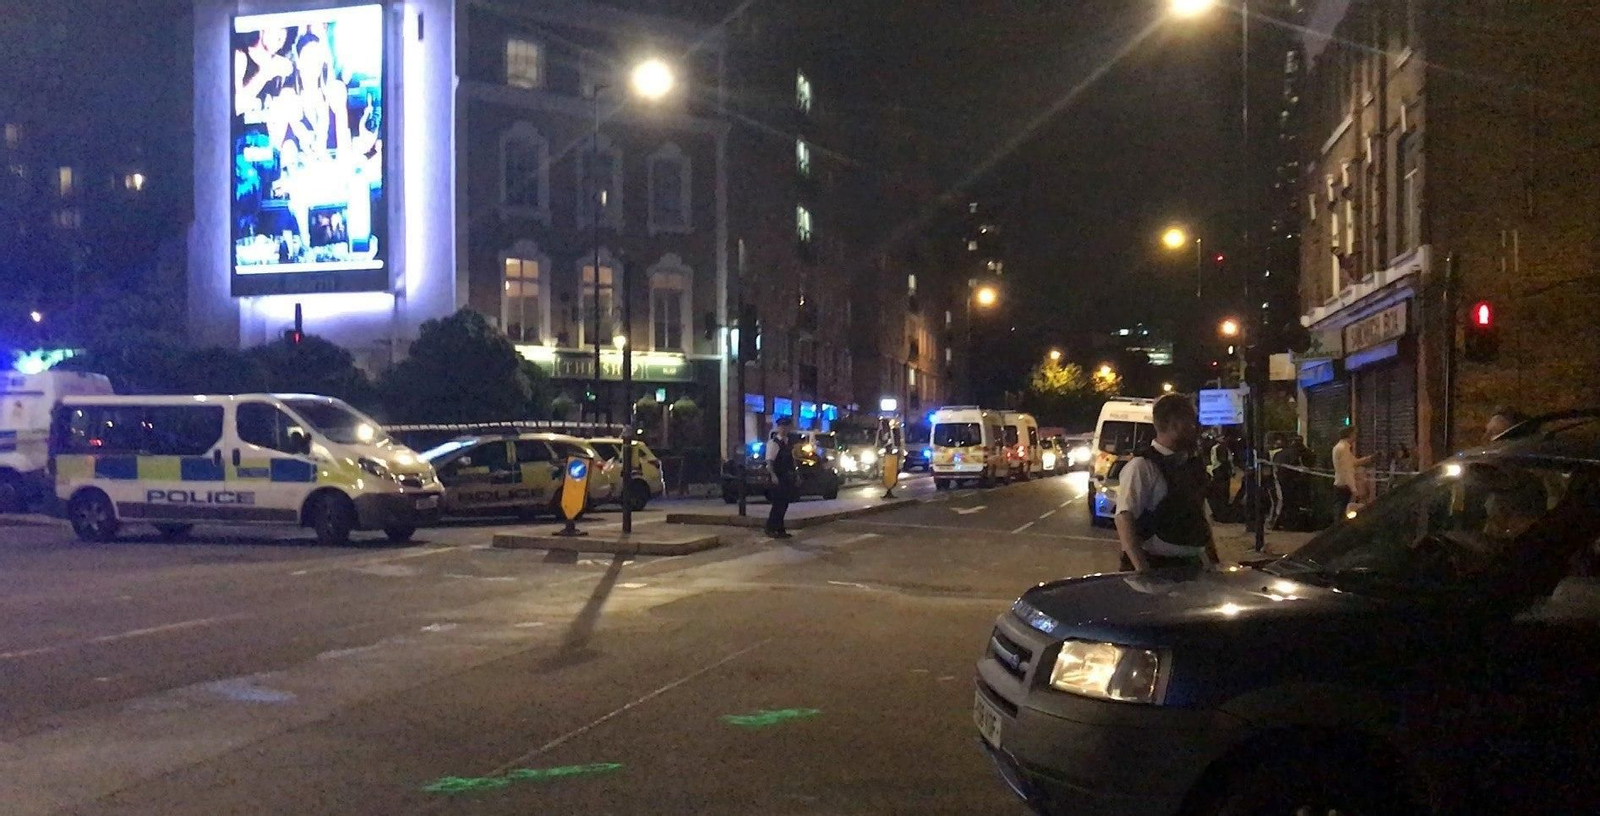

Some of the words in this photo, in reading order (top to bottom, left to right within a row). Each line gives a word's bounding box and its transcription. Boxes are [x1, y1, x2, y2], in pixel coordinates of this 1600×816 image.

[602, 361, 639, 376] SHP
[146, 489, 256, 505] POLICE
[458, 487, 545, 502] POLICE
